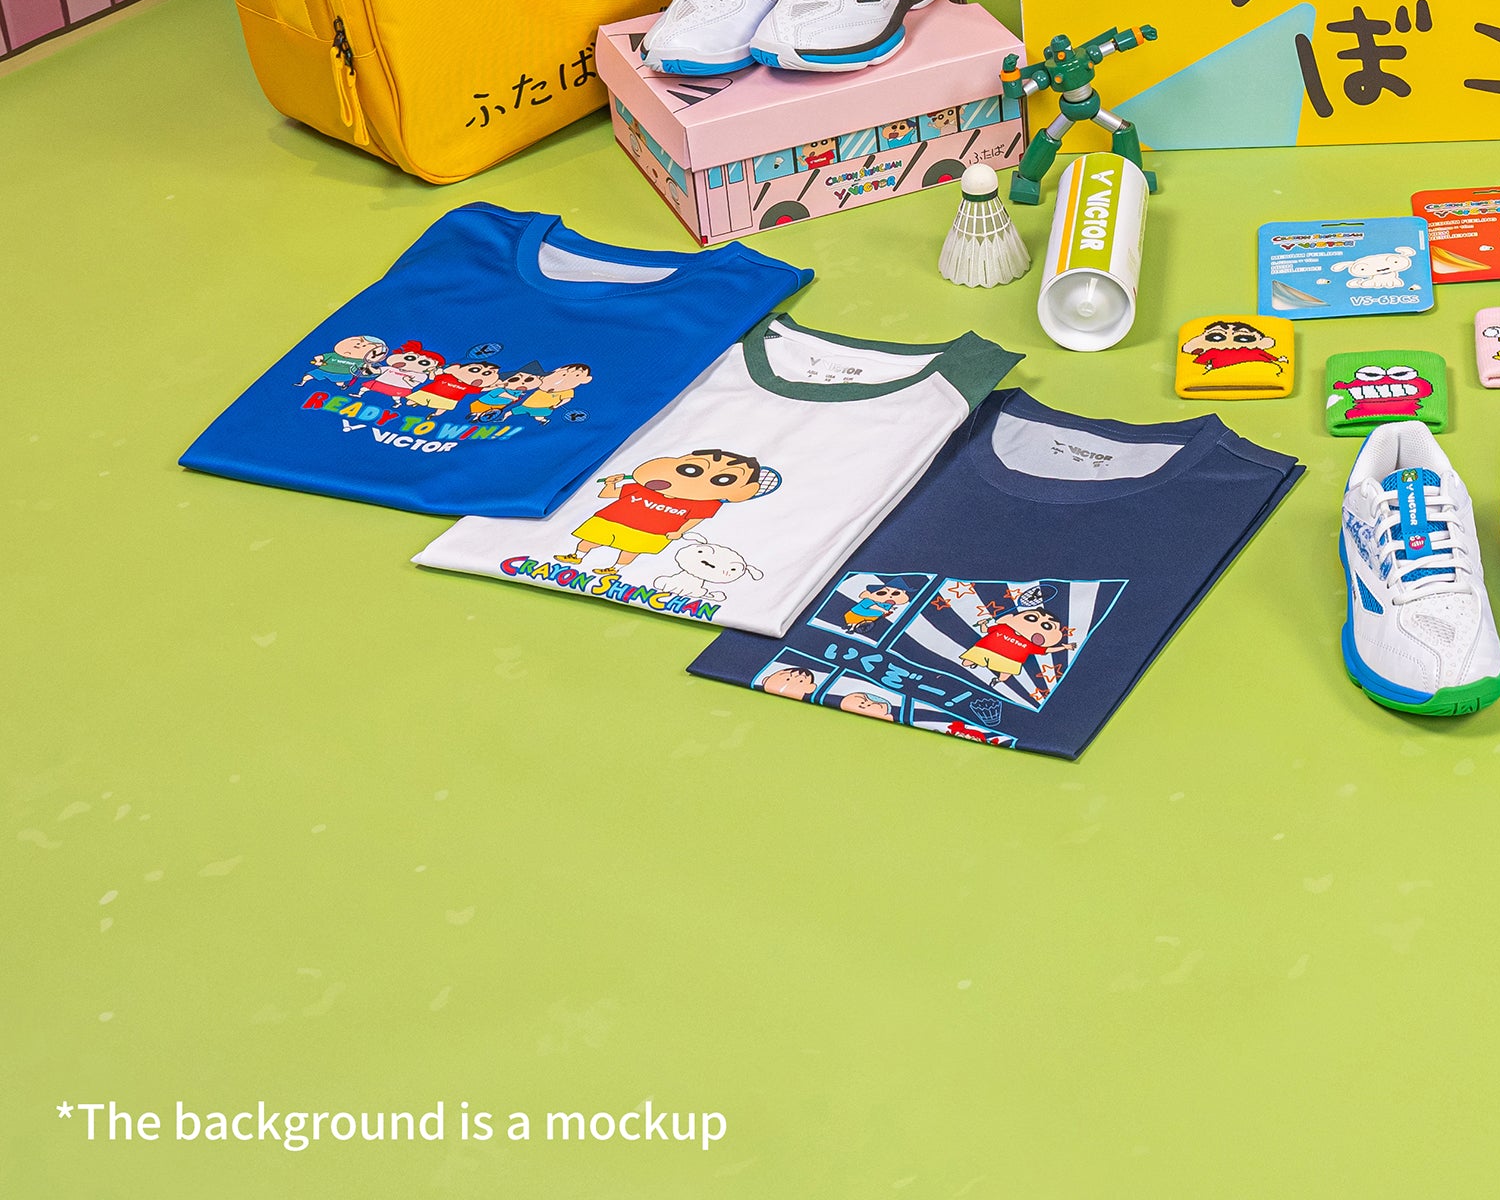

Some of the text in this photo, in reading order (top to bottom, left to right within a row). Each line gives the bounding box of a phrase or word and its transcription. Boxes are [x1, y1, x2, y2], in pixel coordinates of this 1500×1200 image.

[847, 175, 896, 196] VICTOR
[1079, 191, 1111, 251] VICTOR
[1349, 294, 1421, 307] VS-63CS
[301, 390, 526, 442] READY TO WIN!!
[371, 426, 460, 454] VICTOR
[1067, 444, 1114, 461] VICTOR
[643, 498, 687, 518] VICTOR
[1407, 492, 1418, 526] VICTOR
[499, 554, 721, 623] CRAYON SHINCHAN
